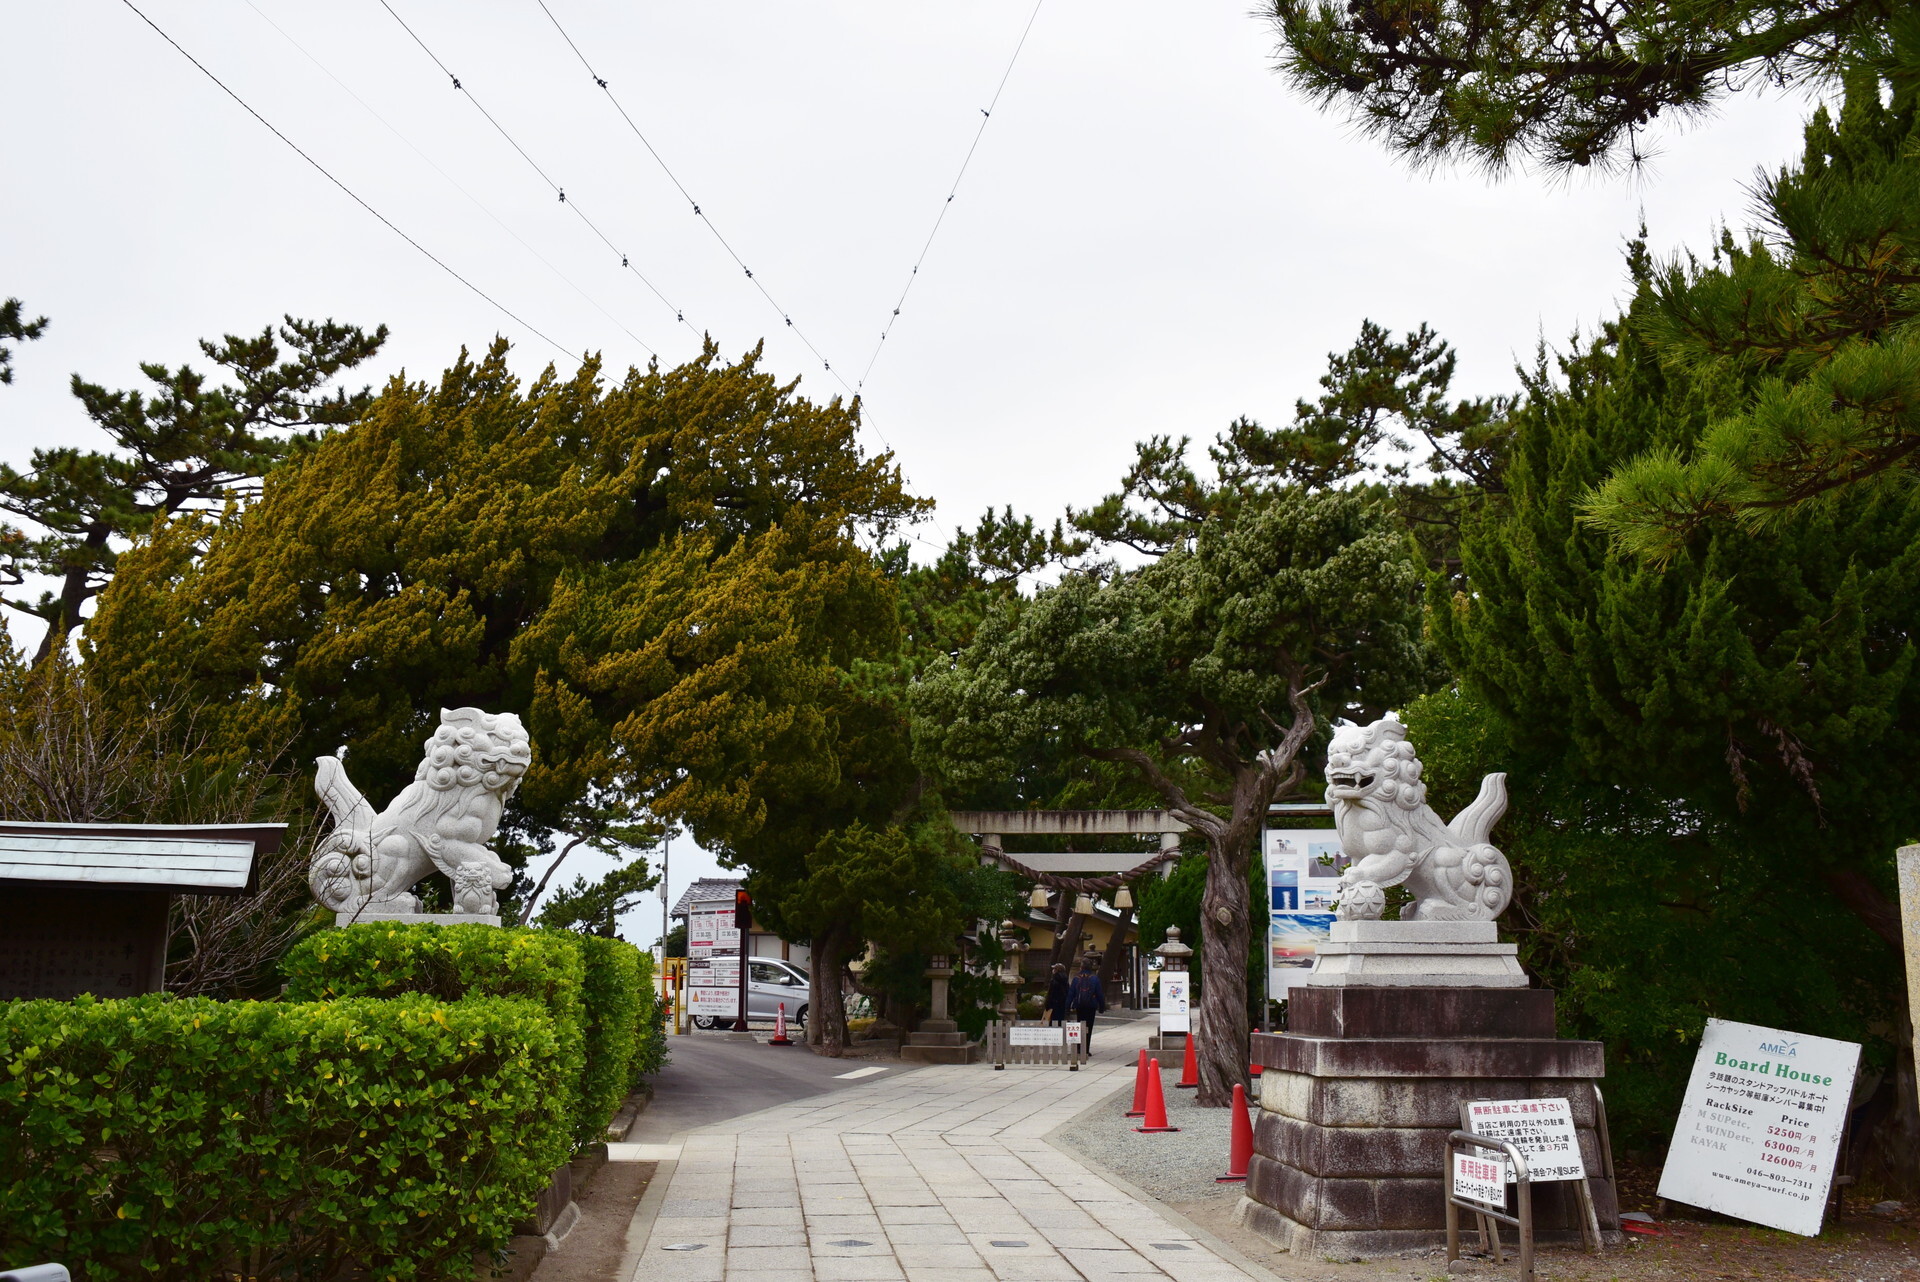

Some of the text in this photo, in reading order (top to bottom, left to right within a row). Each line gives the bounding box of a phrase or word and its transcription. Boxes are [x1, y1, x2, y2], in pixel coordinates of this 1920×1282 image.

[1714, 1051, 1833, 1087] Board House
[1473, 1103, 1564, 1115] 無断駐車ご遠慮下さい
[1697, 1109, 1707, 1119] M
[1706, 1098, 1754, 1116] RackSize
[1781, 1114, 1810, 1129] Price
[1690, 1135, 1728, 1152] KAYAK
[1460, 1159, 1498, 1184] 専用駐車場
[1746, 1167, 1813, 1190] 046-803-7311
[1711, 1170, 1810, 1202] www.ameya-surf.co.jp
